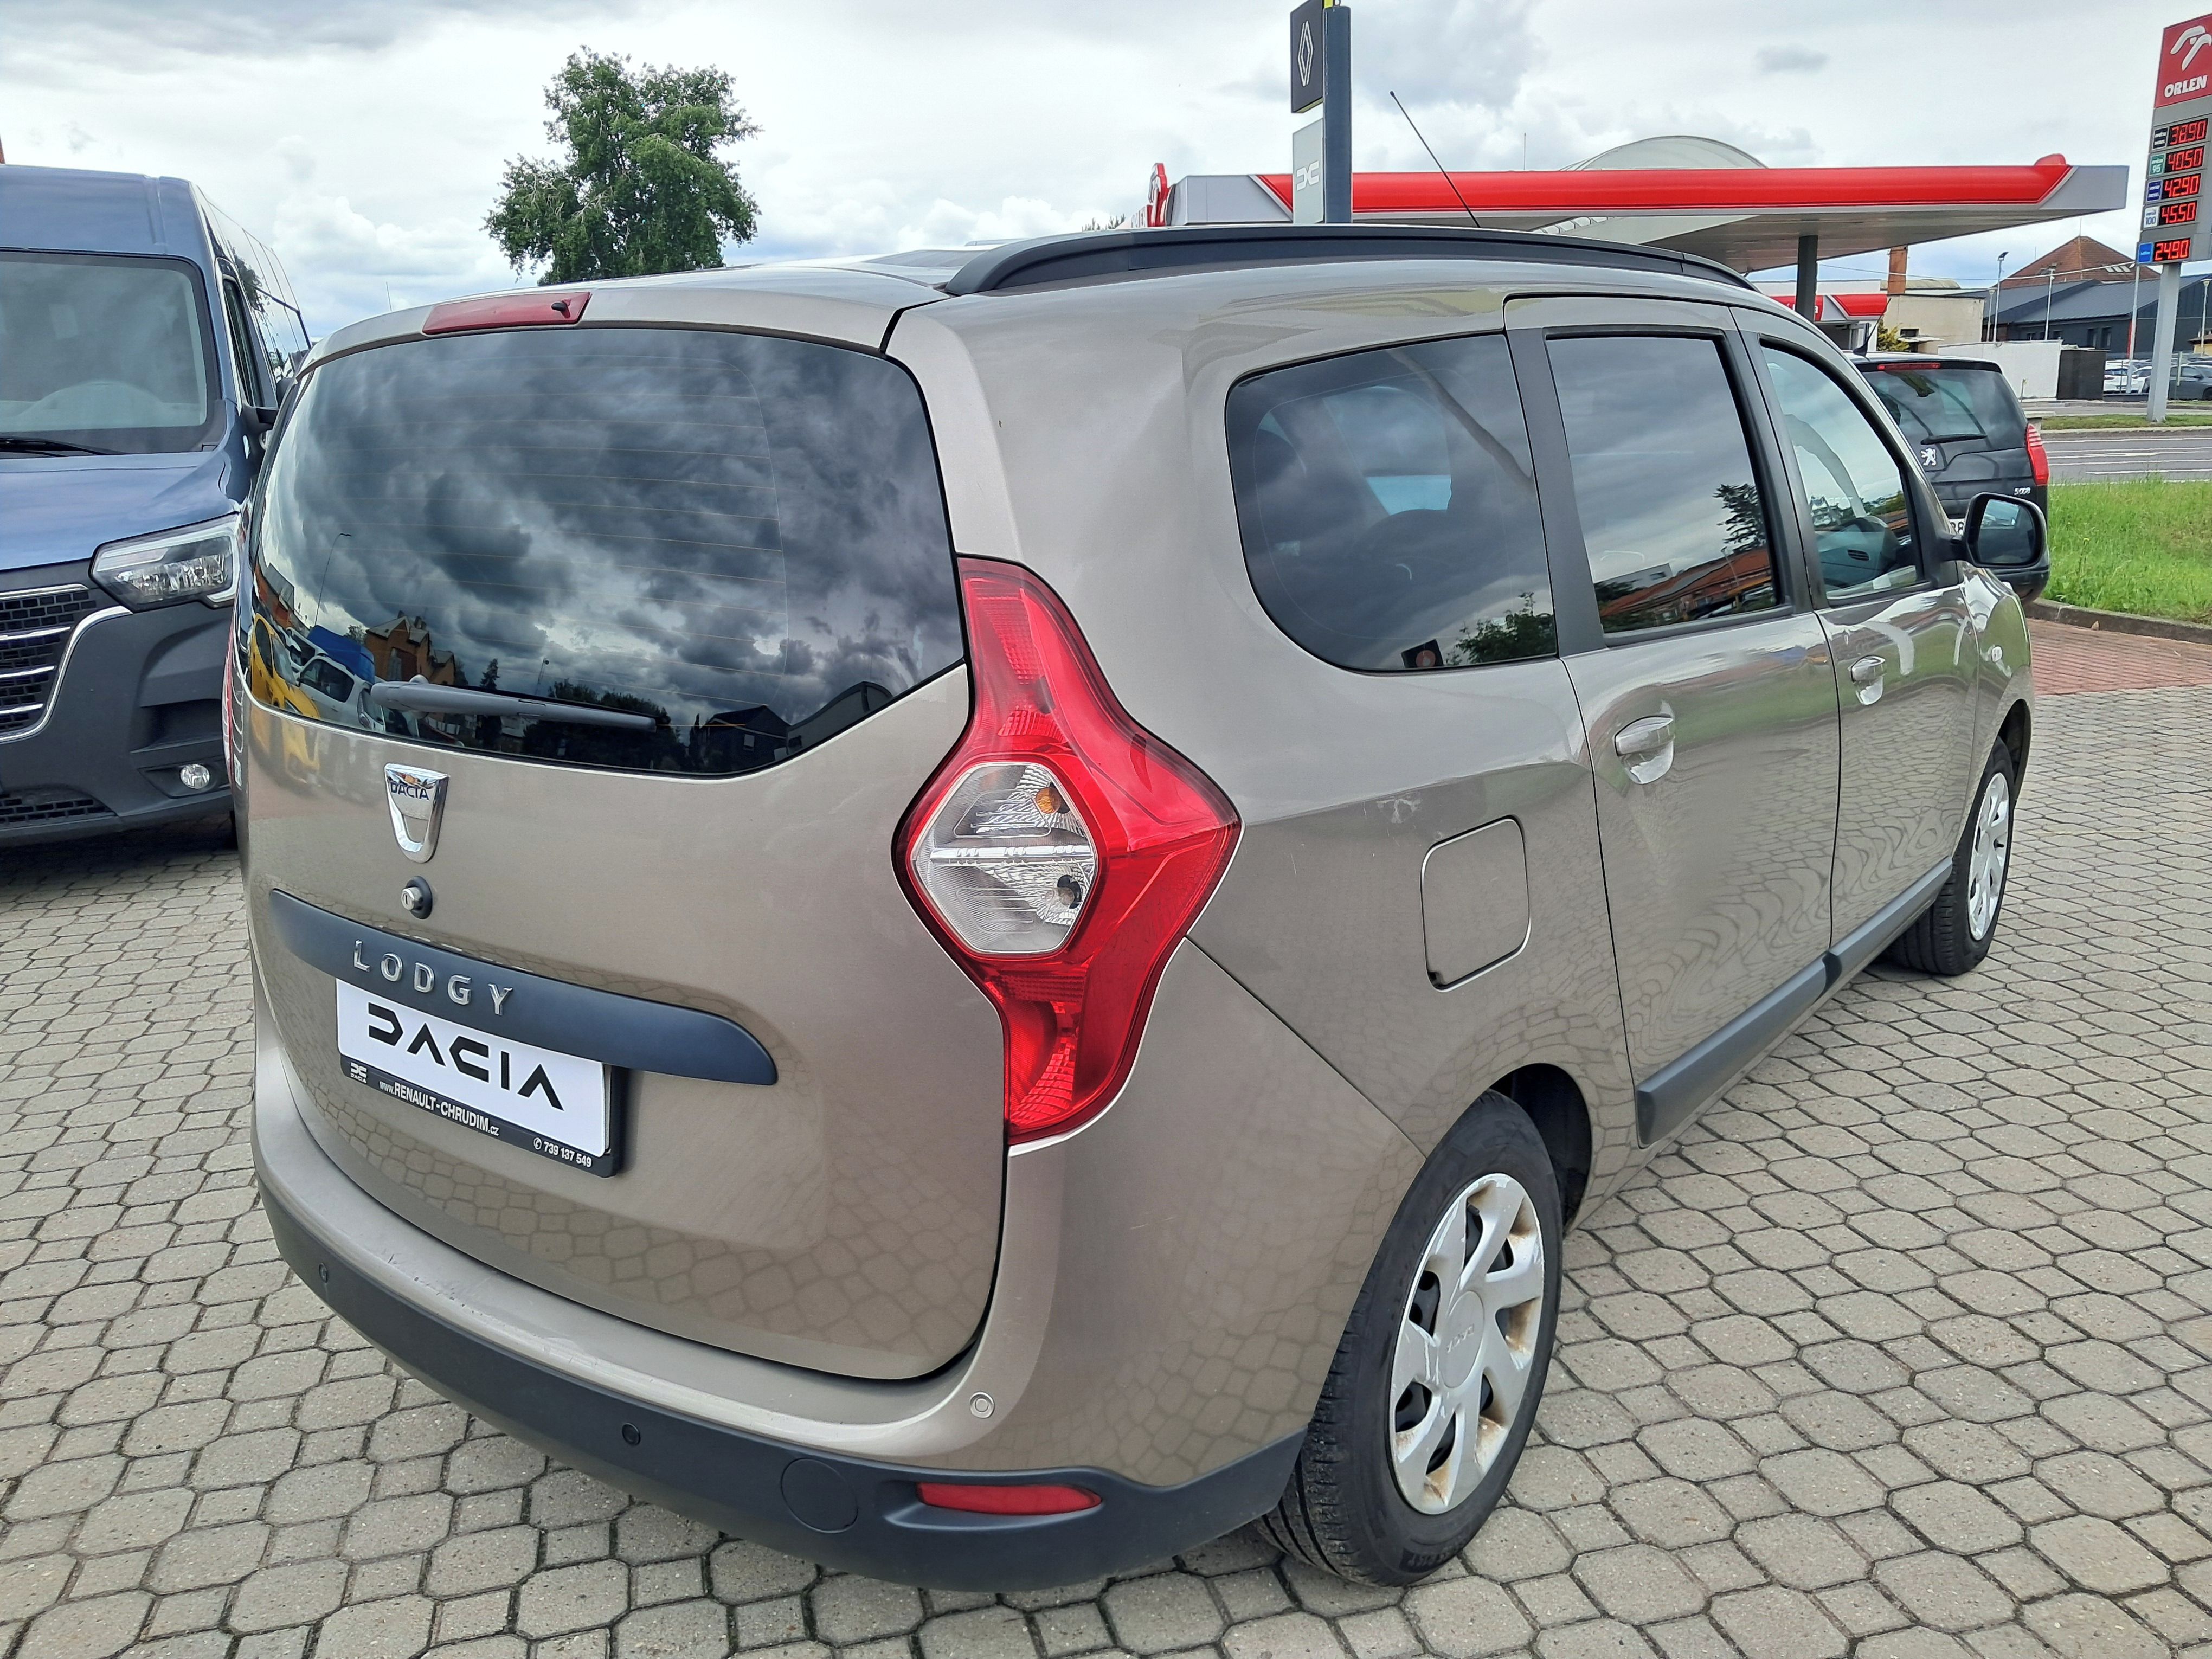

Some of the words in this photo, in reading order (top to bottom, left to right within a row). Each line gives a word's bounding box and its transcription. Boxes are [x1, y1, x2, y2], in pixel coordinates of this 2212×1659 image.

[2164, 75, 2208, 98] ORLEN
[2152, 164, 2162, 173] 95
[2145, 216, 2156, 226] 100
[390, 781, 430, 801] DACIA
[353, 940, 512, 1015] LODGY
[368, 1002, 565, 1111] DACIA
[350, 1073, 367, 1084] DACIA
[544, 1141, 558, 1156] 739
[560, 1147, 575, 1161] 137
[576, 1153, 592, 1168] 549
